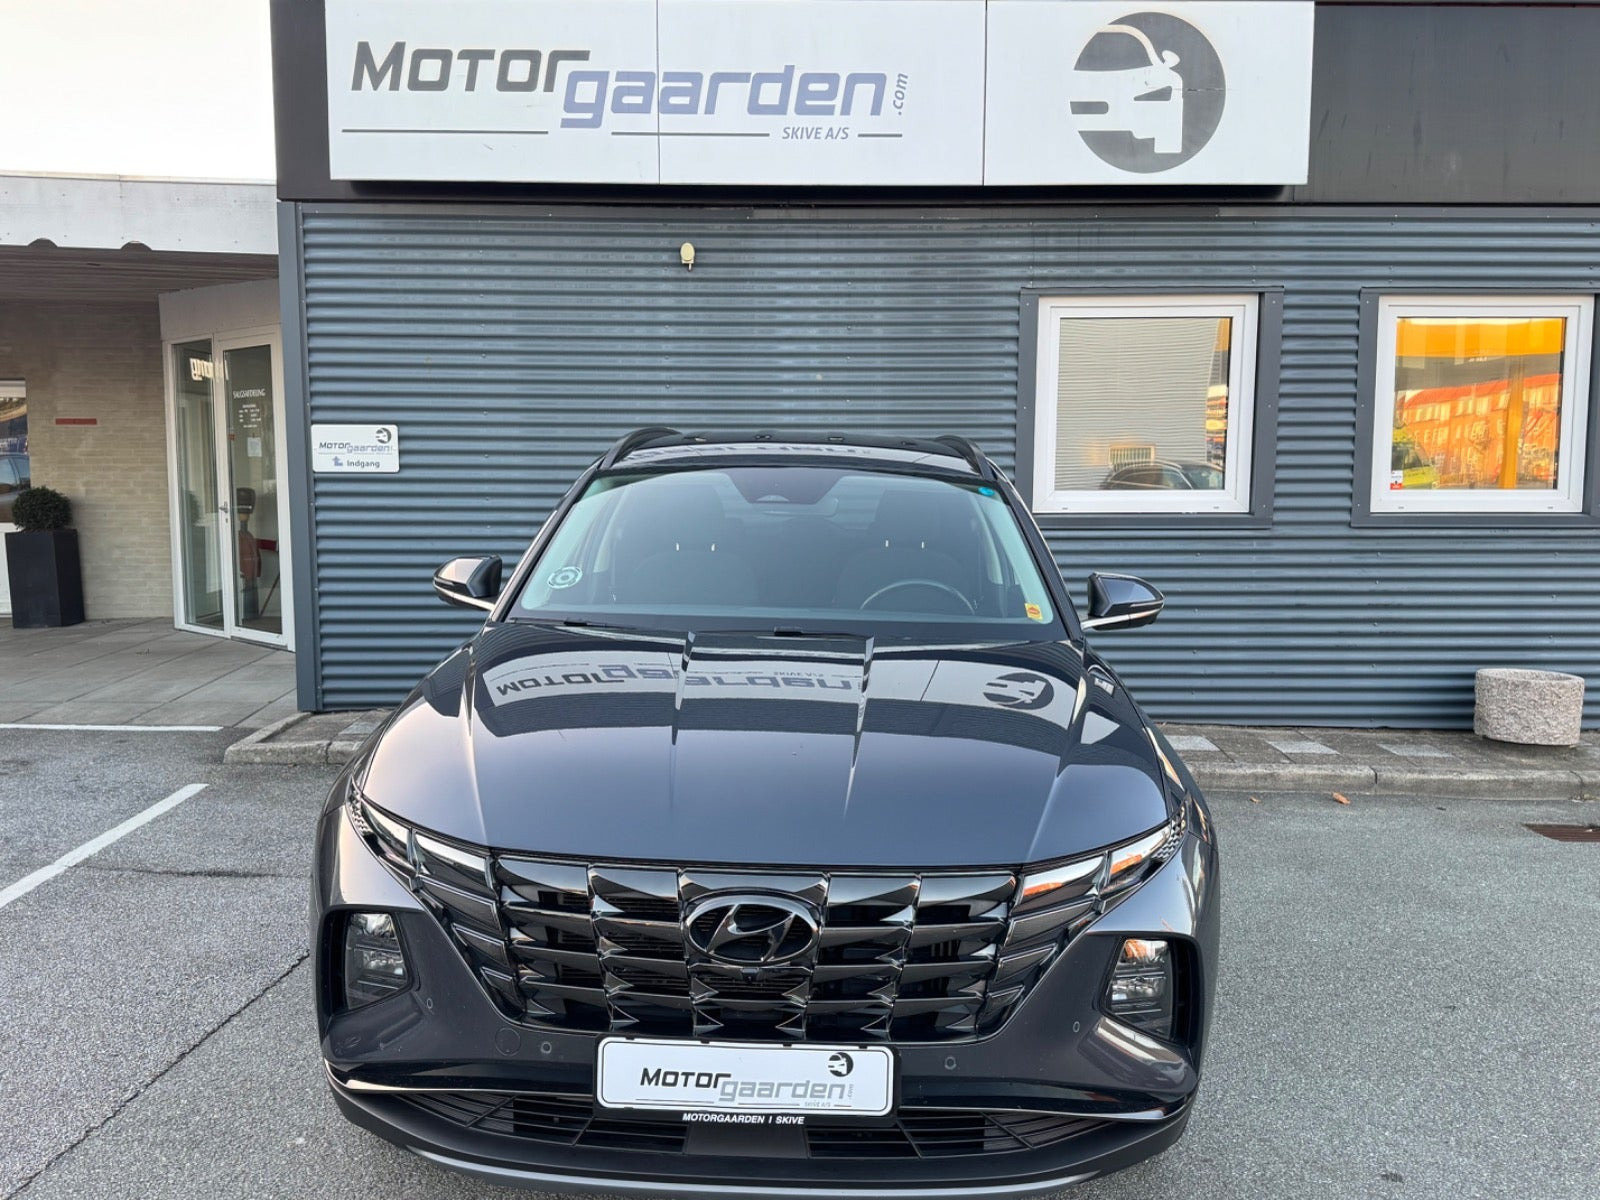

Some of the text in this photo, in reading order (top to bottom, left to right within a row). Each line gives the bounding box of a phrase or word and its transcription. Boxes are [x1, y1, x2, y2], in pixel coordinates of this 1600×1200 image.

[782, 126, 850, 140] SKIVE A/S
[346, 459, 381, 468] Indgang
[682, 1112, 765, 1124] MOTORGAARDEN
[775, 1116, 805, 1125] SKIVE
